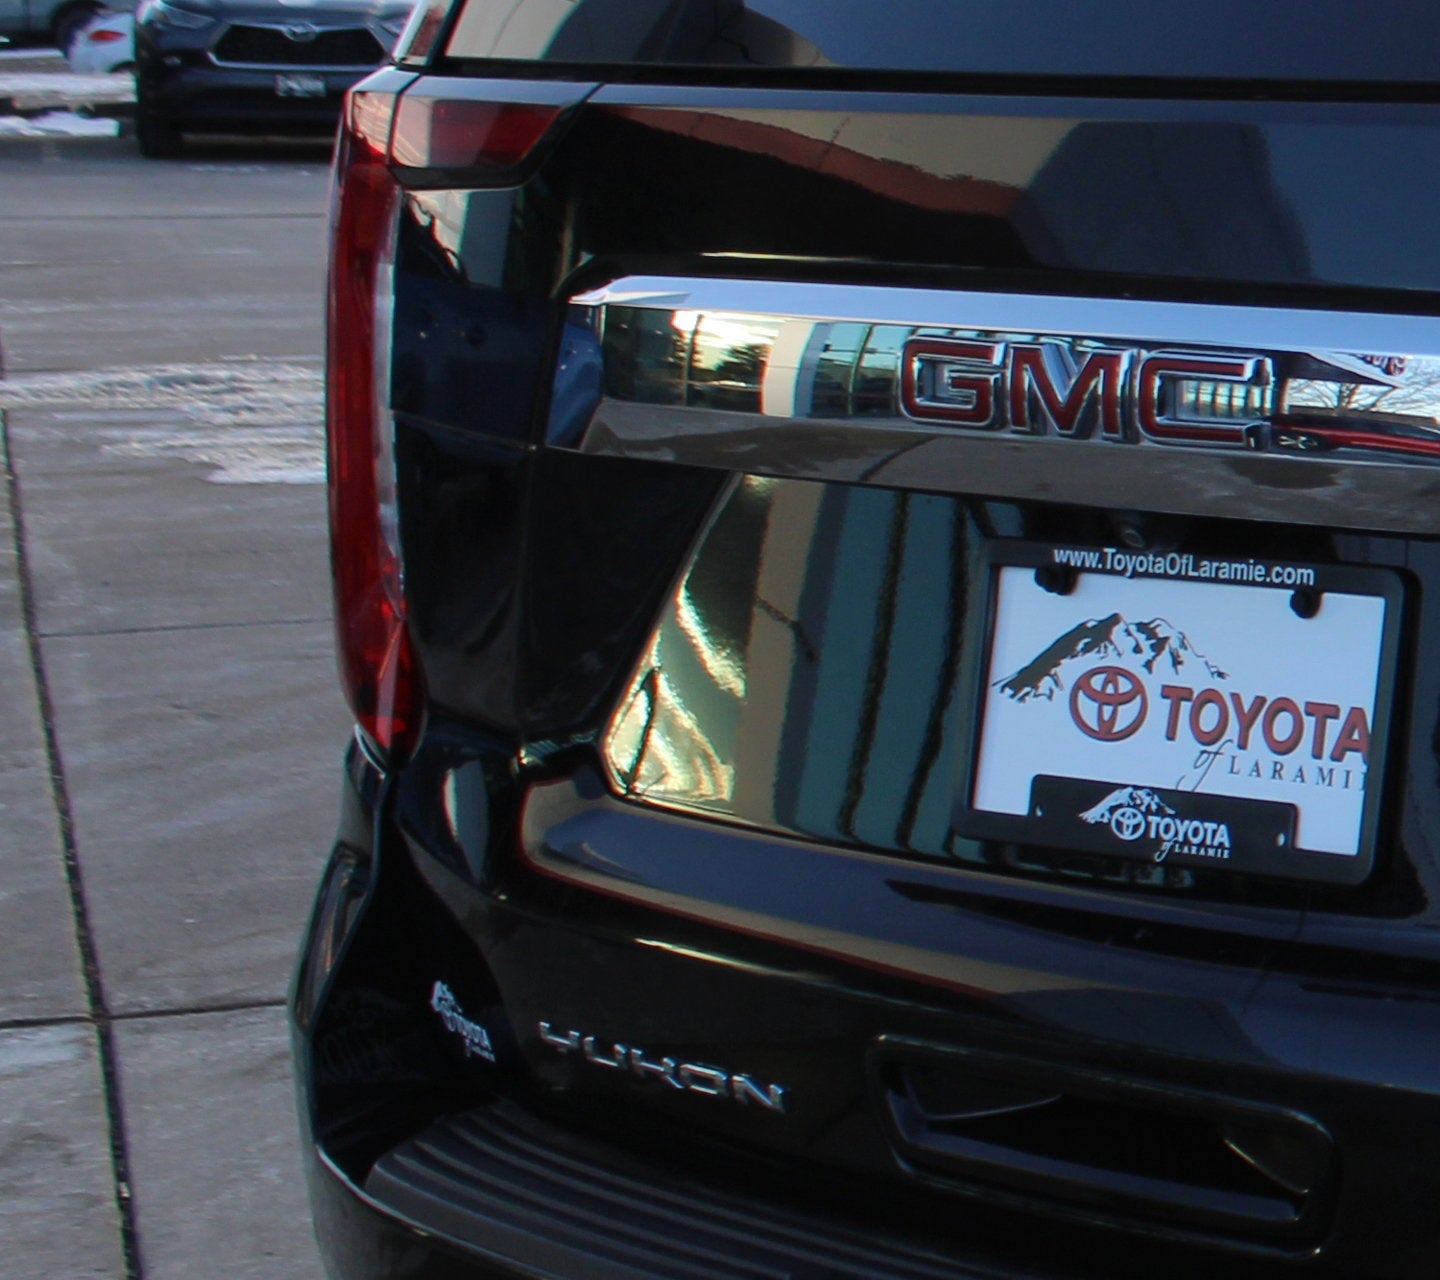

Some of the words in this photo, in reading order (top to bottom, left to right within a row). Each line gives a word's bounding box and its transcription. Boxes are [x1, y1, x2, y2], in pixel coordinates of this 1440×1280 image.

[901, 335, 1271, 451] GMC
[1053, 547, 1315, 587] www.ToyotaOfLaramie.com
[1160, 684, 1372, 763] TOYOTA
[1176, 739, 1234, 791] of
[1147, 815, 1231, 848] TOYOTA
[1154, 837, 1177, 862] of
[1175, 844, 1230, 860] LARAMIE
[537, 1021, 791, 1113] YUKON
